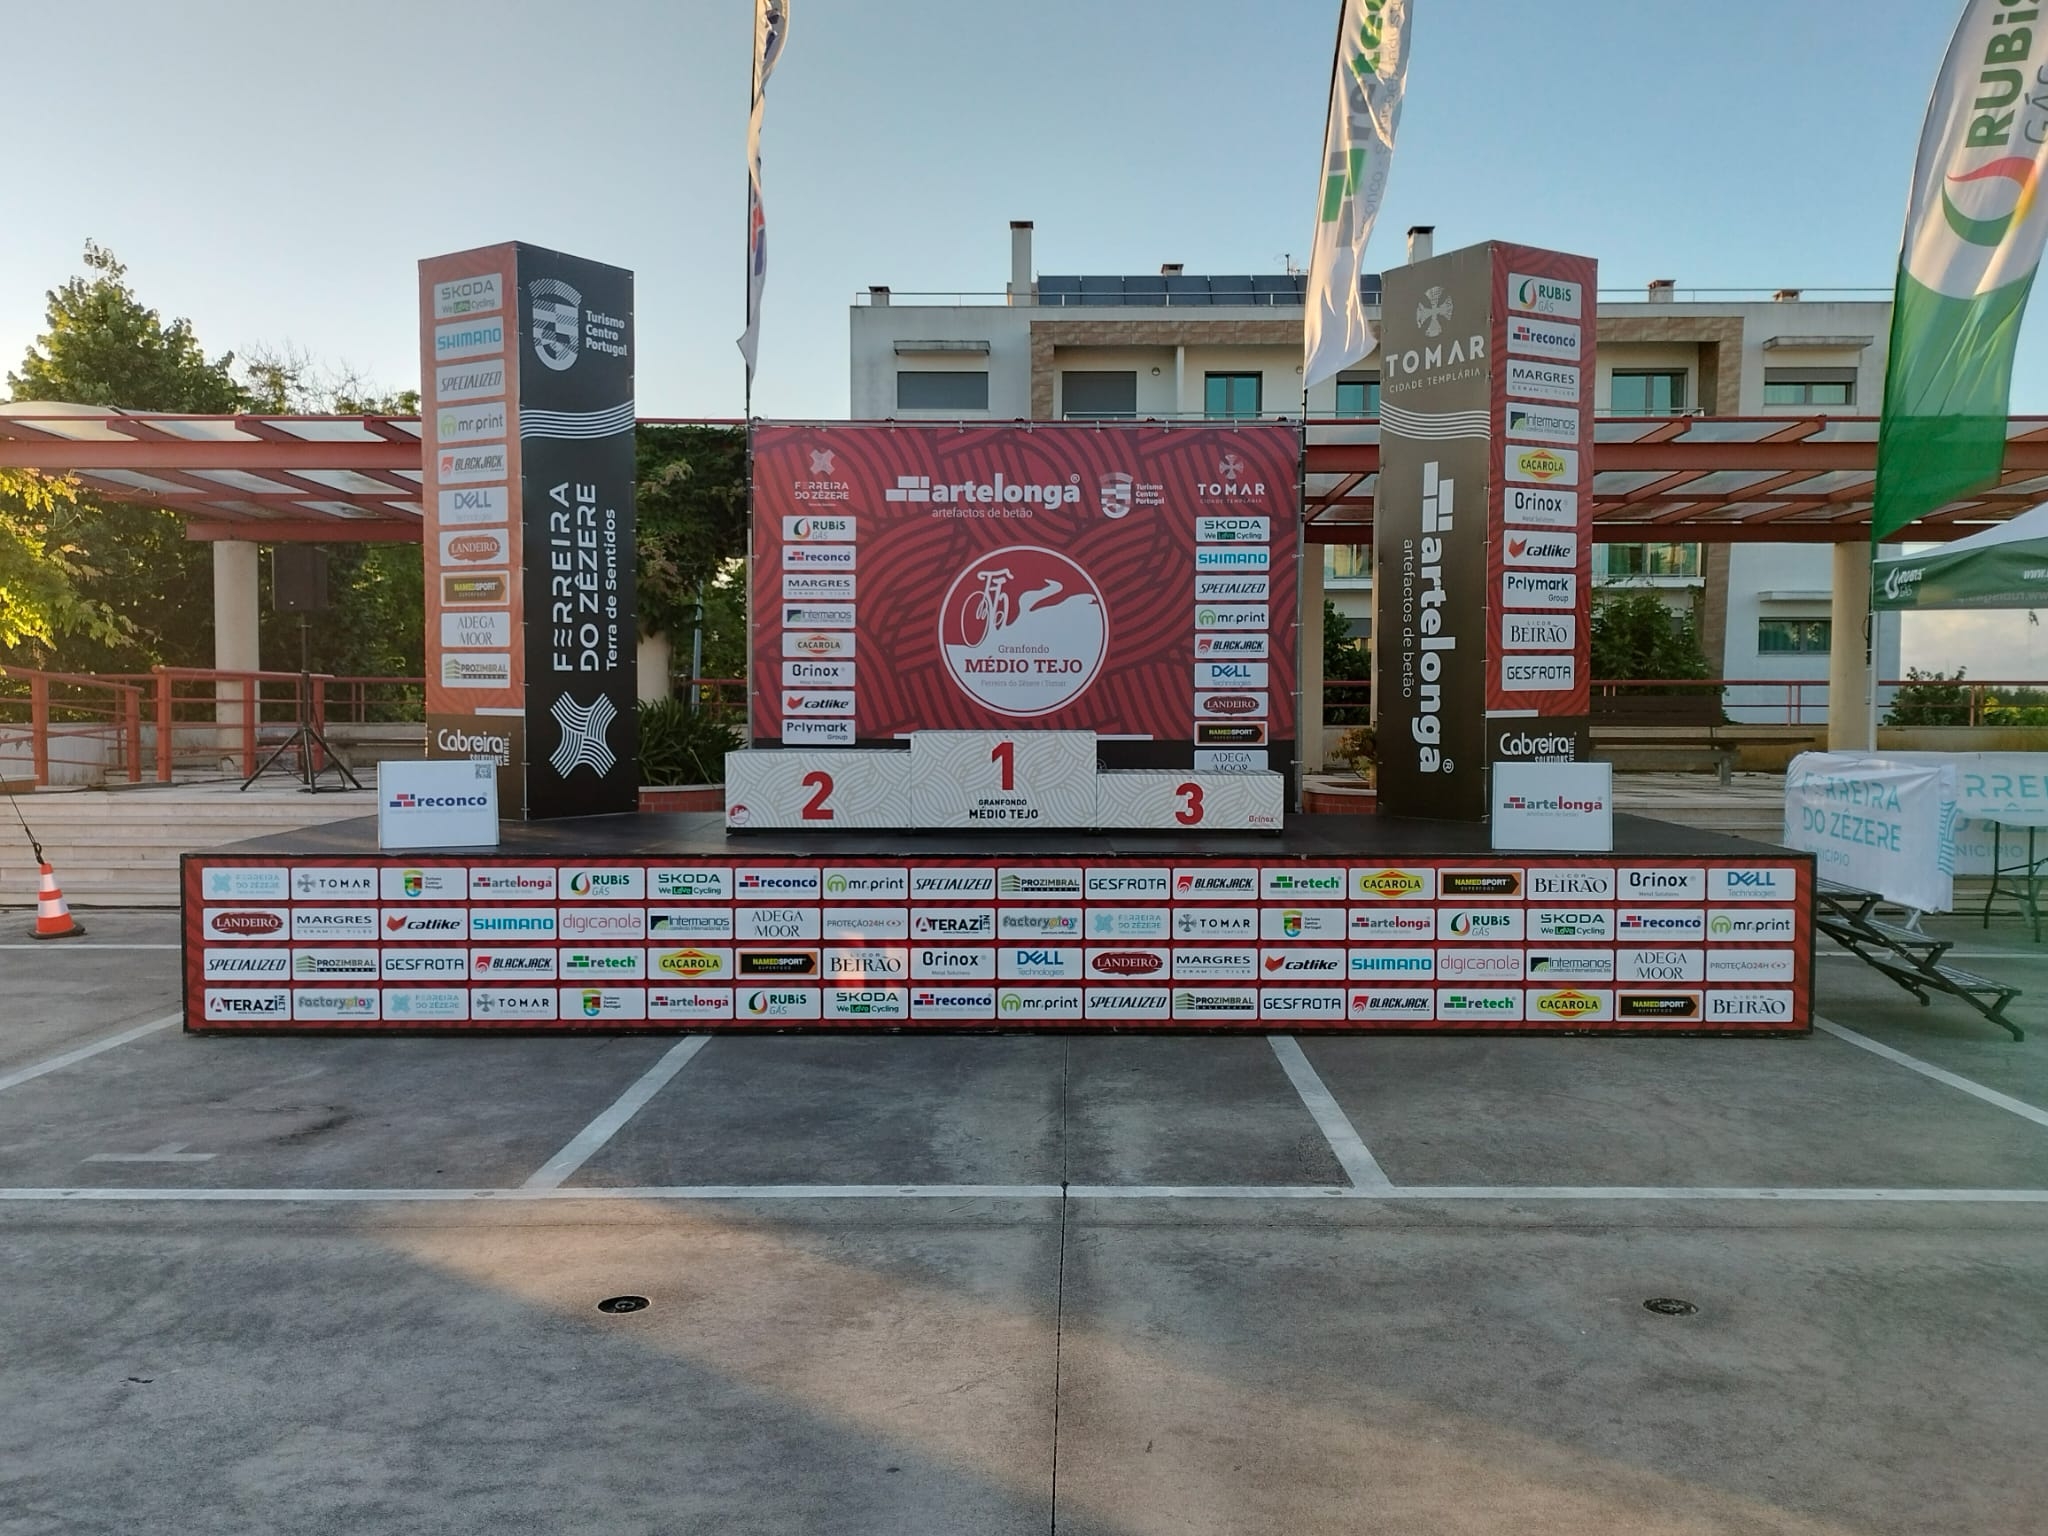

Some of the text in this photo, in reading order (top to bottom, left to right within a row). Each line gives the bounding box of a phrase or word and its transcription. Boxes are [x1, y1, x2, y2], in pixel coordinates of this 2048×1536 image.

[586, 310, 625, 329] Turismo
[438, 327, 501, 350] SHIMANO
[586, 324, 618, 341] Centro
[1531, 331, 1576, 347] reconco
[586, 338, 627, 357] Portugal
[1386, 335, 1485, 378] TOMAR
[440, 371, 503, 392] SPECIALIZED
[1512, 367, 1575, 384] MARGRES
[1389, 380, 1423, 393] CIDADE
[1525, 413, 1576, 430] Intermanos
[454, 455, 503, 471] BLACKJACK
[1136, 483, 1163, 491] Turismo
[1198, 483, 1265, 496] TOMAR
[454, 491, 491, 510] DELL
[1136, 498, 1165, 506] Portugal
[1515, 492, 1562, 512] Brinox
[932, 507, 1032, 518] artefactos de betão
[1236, 531, 1262, 541] Cycling
[451, 540, 498, 554] LANDEIRO
[1527, 543, 1571, 558] catlike
[805, 553, 850, 562] reconco
[1198, 553, 1267, 564] SHIMANO
[550, 482, 573, 672] FERREIRA
[574, 483, 599, 672] DO ZÊZERE
[788, 579, 850, 587] MARGRES
[604, 508, 618, 671] Terra de Sentidos
[1200, 583, 1266, 593] SPECIALIZED
[1507, 576, 1569, 593] Polymark
[1548, 594, 1569, 603] Group
[802, 610, 852, 620] Intermanos
[1217, 610, 1265, 624] mr.print
[1402, 538, 1415, 698] artefactos de betão
[457, 616, 495, 629] ADEGA
[460, 632, 493, 645] MOOR
[1510, 624, 1568, 643] BEIRÃO
[998, 644, 1050, 654] Granfondo
[1213, 640, 1264, 650] BLACKJACK
[461, 663, 508, 674] PROZIMBRAL
[792, 664, 839, 677] Brinox
[965, 656, 1083, 673] MÉDIO TEJO
[1211, 664, 1251, 678] DELL
[1506, 666, 1571, 680] GESFROTA
[804, 699, 849, 709] catlike
[1207, 700, 1256, 709] LANDEIRO
[786, 722, 847, 733] Polymark
[438, 729, 504, 753] Cabreira
[1499, 731, 1569, 755] Cabreira
[1211, 753, 1251, 763] ADEGA
[991, 741, 1015, 791] 1
[417, 795, 487, 807] reconco
[801, 771, 834, 821] 2
[1174, 782, 1205, 825] 3
[1527, 796, 1602, 813] artelonga
[969, 806, 1039, 819] MÉDIO TEJO
[1802, 806, 1826, 835] DO
[320, 879, 371, 888] TOMAR
[492, 876, 552, 888] artelonga
[761, 878, 817, 888] reconco
[848, 877, 904, 891] mr.print
[913, 878, 992, 890] SPECIALIZED
[1089, 879, 1166, 890] GESFROTA
[1194, 878, 1254, 889] BLACKJACK
[1294, 876, 1340, 889] retech
[1535, 877, 1607, 893] BEIRÃO
[1630, 872, 1687, 887] Brinox
[1728, 872, 1775, 886] DELL
[658, 887, 721, 896] We Cycling
[1728, 889, 1776, 898] Technologies
[216, 917, 279, 927] LANDEIRO
[297, 915, 372, 924] MARGRES
[669, 915, 730, 926] Intermanos
[751, 910, 803, 922] ADEGA
[407, 919, 460, 930] catlike
[473, 918, 554, 929] SHIMANO
[562, 914, 641, 933] digicanola
[1003, 915, 1078, 930] factoryplay
[1200, 919, 1251, 928] TOMAR
[1370, 916, 1430, 930] artelonga
[1643, 918, 1701, 928] reconco
[1733, 917, 1790, 932] mr.print
[754, 925, 800, 937] MOOR
[1541, 927, 1605, 936] We Cycling
[492, 958, 552, 969] BLACKJACK
[591, 956, 636, 967] retech
[831, 956, 901, 972] BEIRÃO
[923, 951, 979, 966] Brinox
[1017, 951, 1063, 965] DELL
[1097, 957, 1159, 967] LANDEIRO
[1176, 956, 1251, 964] MARGRES
[1352, 958, 1431, 970] SHIMANO
[1550, 957, 1611, 968] Intermanos
[1634, 952, 1687, 964] ADEGA
[206, 959, 286, 970] SPECIALIZED
[385, 959, 464, 970] GESFROTA
[1285, 960, 1338, 970] catlike
[1441, 955, 1519, 974] digicanola
[1018, 968, 1064, 977] Technologies
[1636, 967, 1684, 979] MOOR
[298, 996, 374, 1009] factoryplay
[499, 998, 550, 1007] TOMAR
[669, 995, 728, 1008] artelonga
[935, 996, 992, 1006] reconco
[1023, 997, 1079, 1011] mr.print
[1088, 996, 1167, 1008] SPECIALIZED
[1264, 998, 1341, 1009] GESFROTA
[1369, 998, 1429, 1009] BLACKJACK
[1468, 997, 1514, 1009] retech
[1712, 998, 1786, 1014] BEIRÃO
[871, 1005, 899, 1013] Cycling
